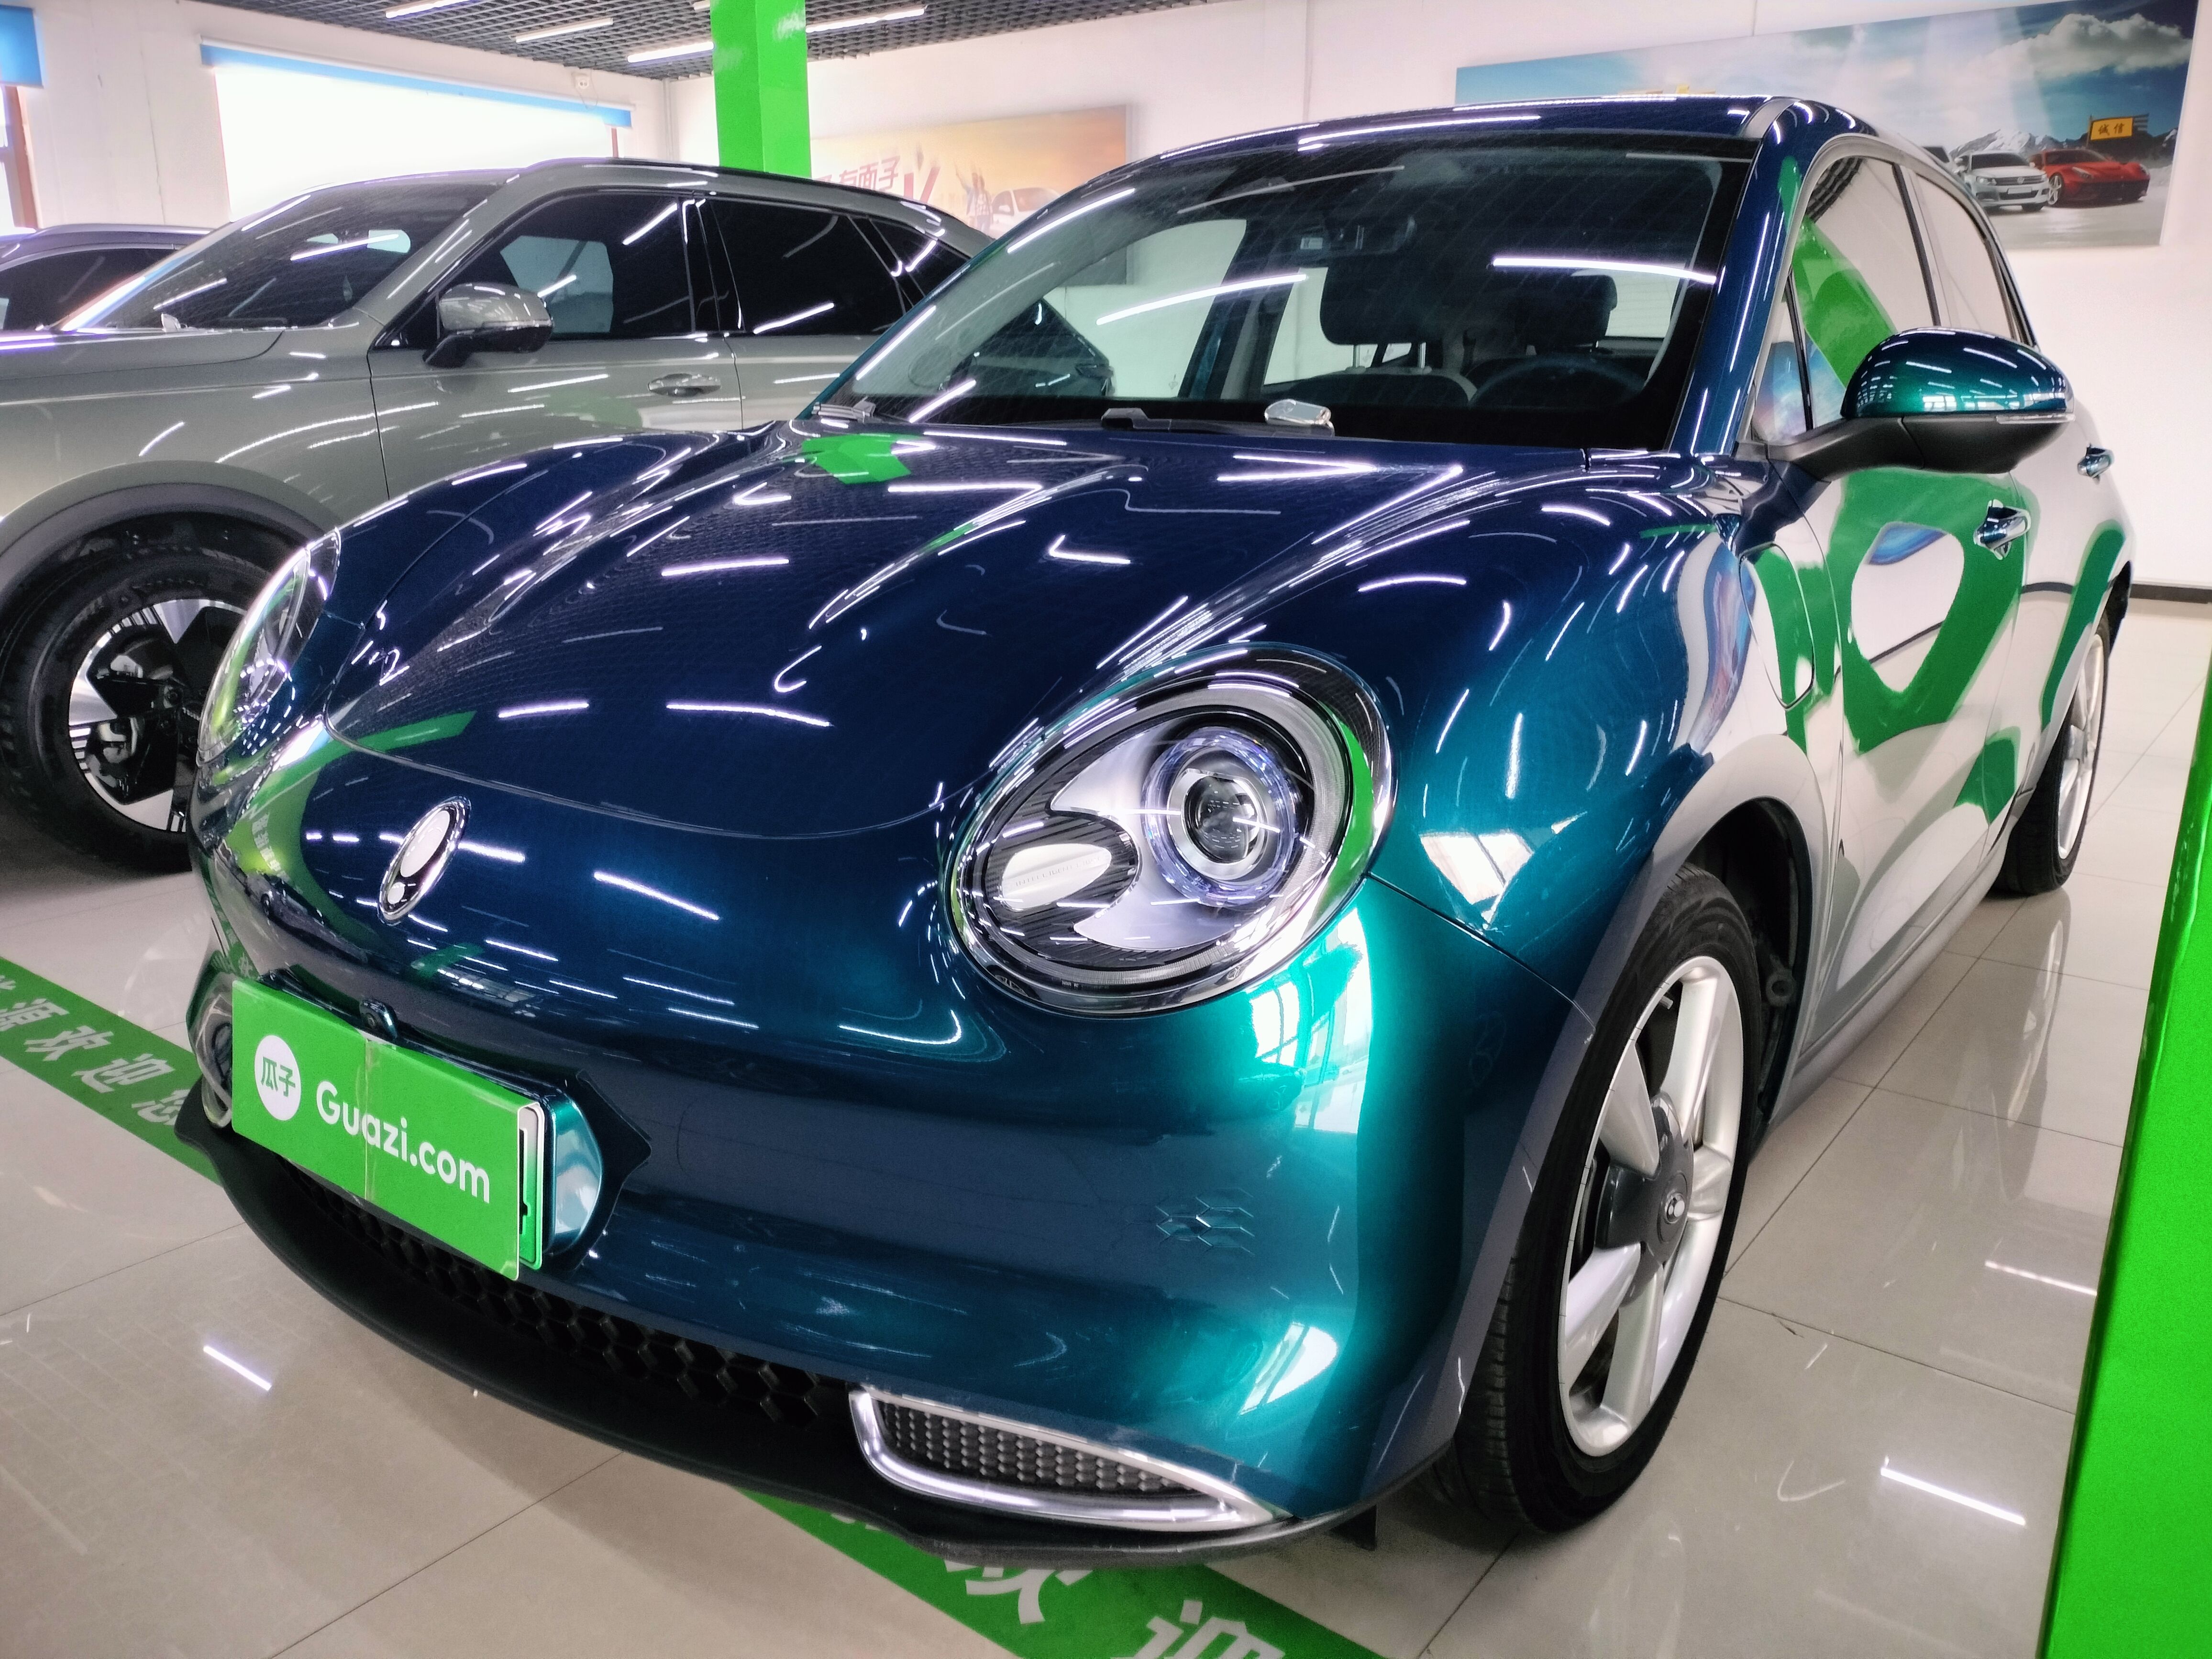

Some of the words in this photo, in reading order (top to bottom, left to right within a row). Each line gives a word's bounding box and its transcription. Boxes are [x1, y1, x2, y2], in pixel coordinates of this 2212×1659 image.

[2098, 122, 2124, 135] 诚信
[816, 155, 900, 190] 有面子
[0, 975, 190, 1126] 源欢迎您
[261, 1056, 296, 1097] 瓜子
[316, 1080, 490, 1204] Guazi.com
